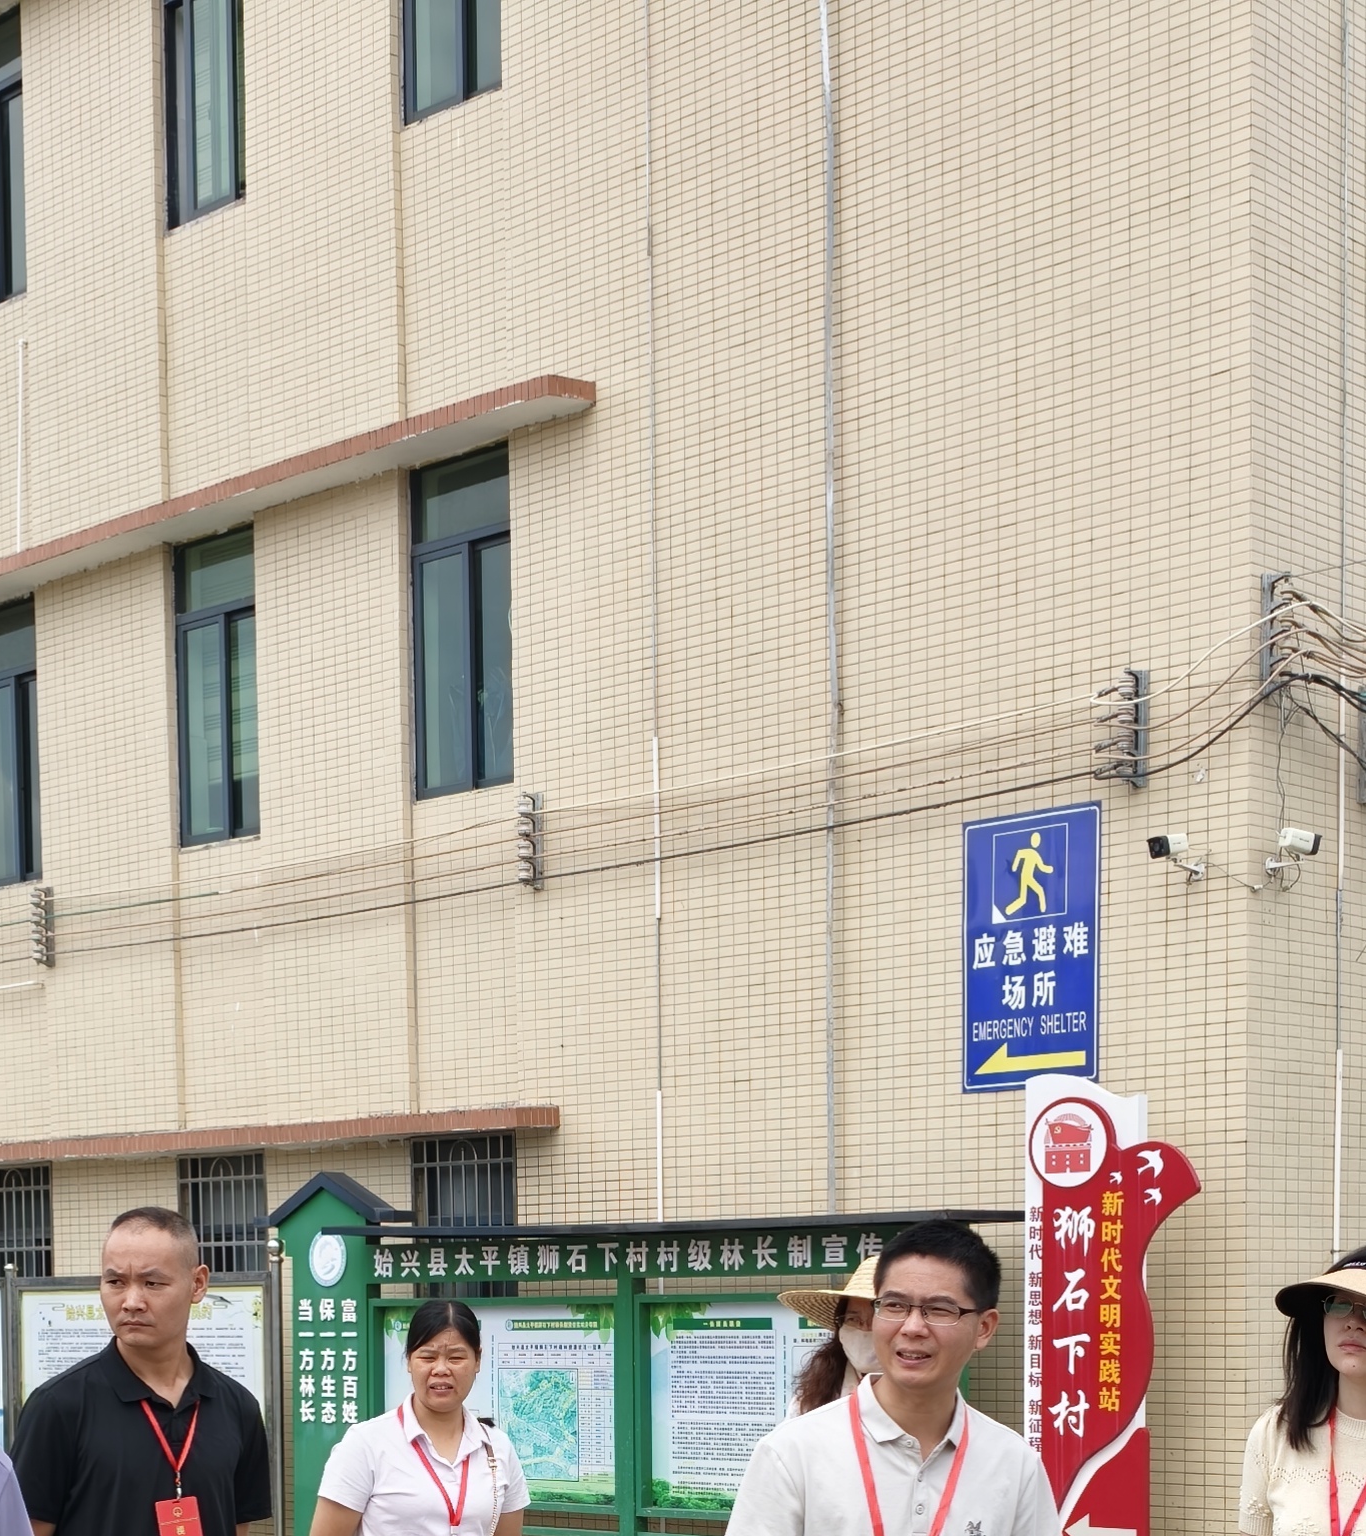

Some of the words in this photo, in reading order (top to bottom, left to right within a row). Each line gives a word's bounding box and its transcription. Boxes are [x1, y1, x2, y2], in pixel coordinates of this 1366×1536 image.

[972, 922, 1089, 970] 应急避难
[1002, 971, 1057, 1011] 场所
[972, 1016, 1035, 1042] EMERGENCY
[1040, 1011, 1087, 1035] SHELTER
[1029, 1206, 1043, 1261] 新时代
[1028, 1271, 1043, 1326] 新思想
[1047, 1205, 1096, 1438] 狮石下村
[1098, 1190, 1125, 1412] 新时代文明实践站
[298, 1298, 315, 1424] 当一方林长
[319, 1298, 337, 1424] 保一方生态
[341, 1298, 359, 1424] 富一方百姓
[1028, 1334, 1043, 1389] 新目标
